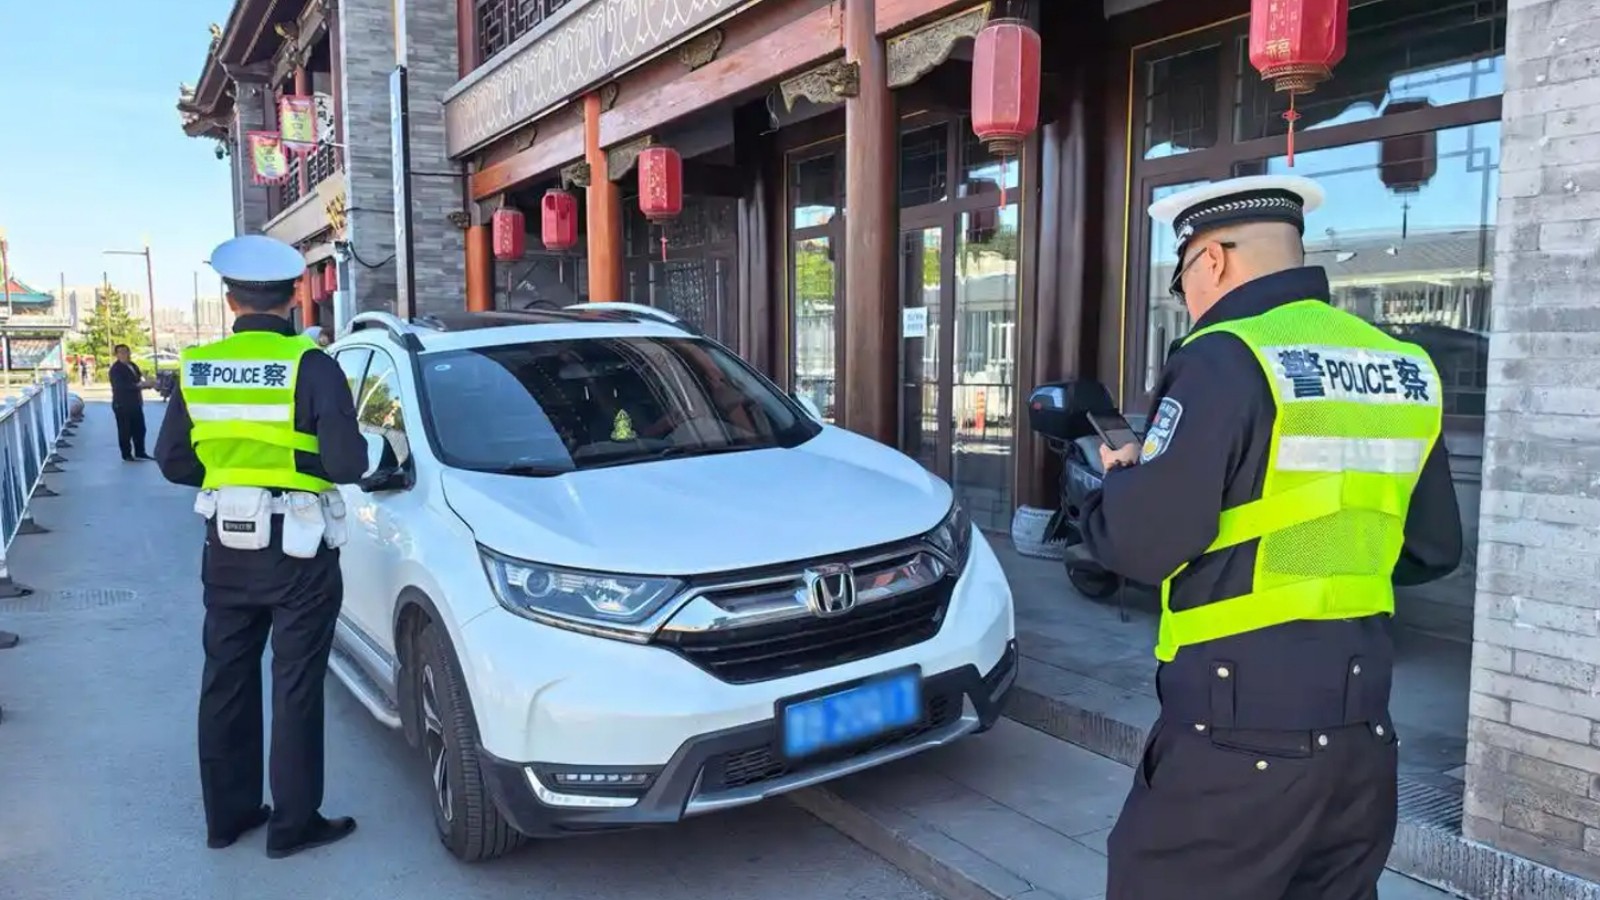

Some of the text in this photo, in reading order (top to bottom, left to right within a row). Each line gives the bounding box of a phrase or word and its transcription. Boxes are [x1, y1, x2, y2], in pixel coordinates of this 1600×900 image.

[190, 362, 287, 386] 警 POLICE 察
[1278, 350, 1429, 401] 警 POLICE 察
